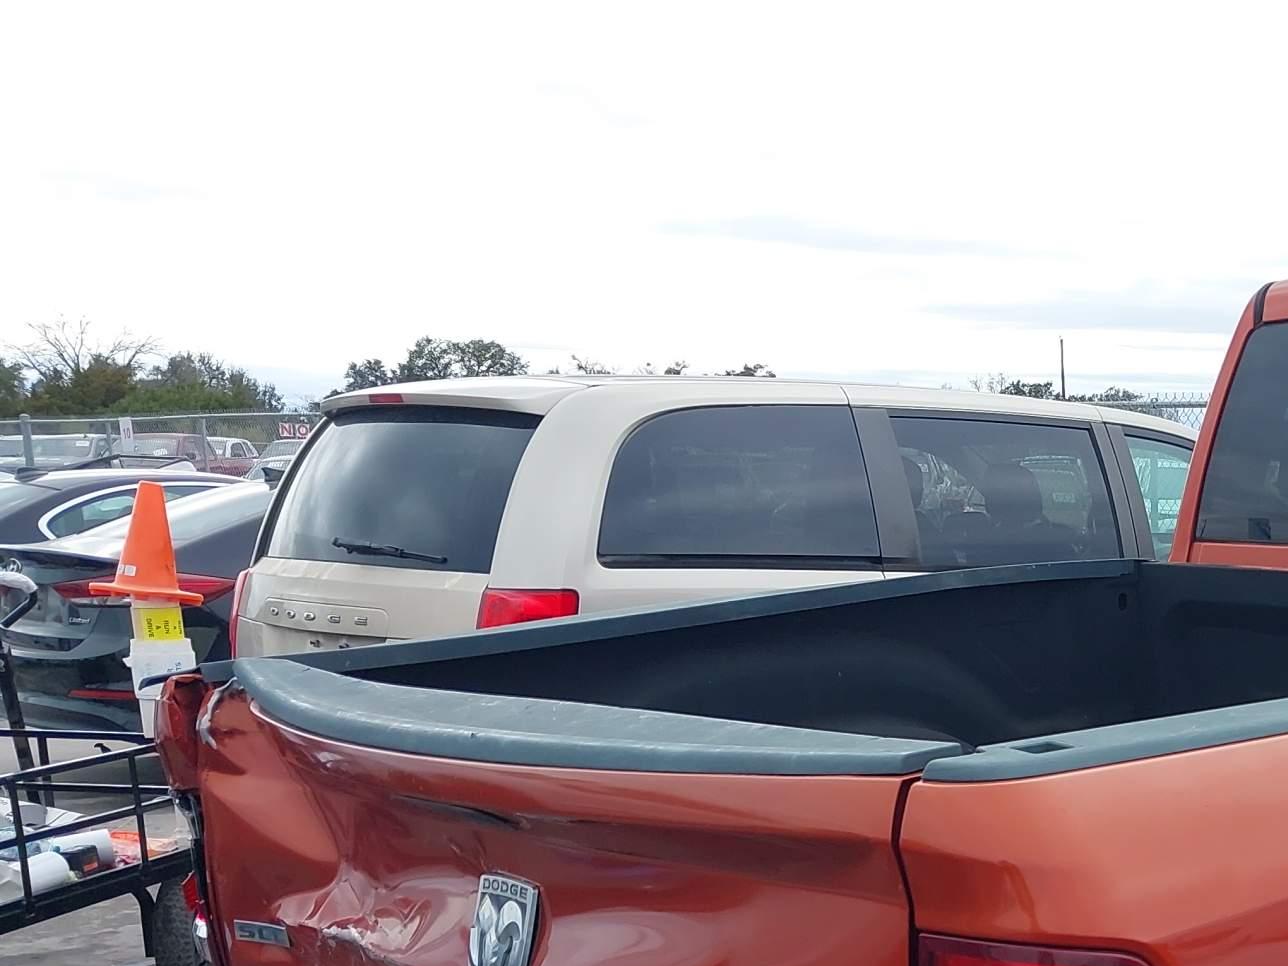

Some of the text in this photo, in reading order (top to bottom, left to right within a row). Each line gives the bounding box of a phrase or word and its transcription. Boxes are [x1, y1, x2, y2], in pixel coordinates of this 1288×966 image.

[122, 427, 131, 440] 10
[281, 424, 309, 436] NO
[270, 606, 368, 626] DODGE
[145, 618, 155, 639] DRIVE
[482, 878, 529, 901] DODGE
